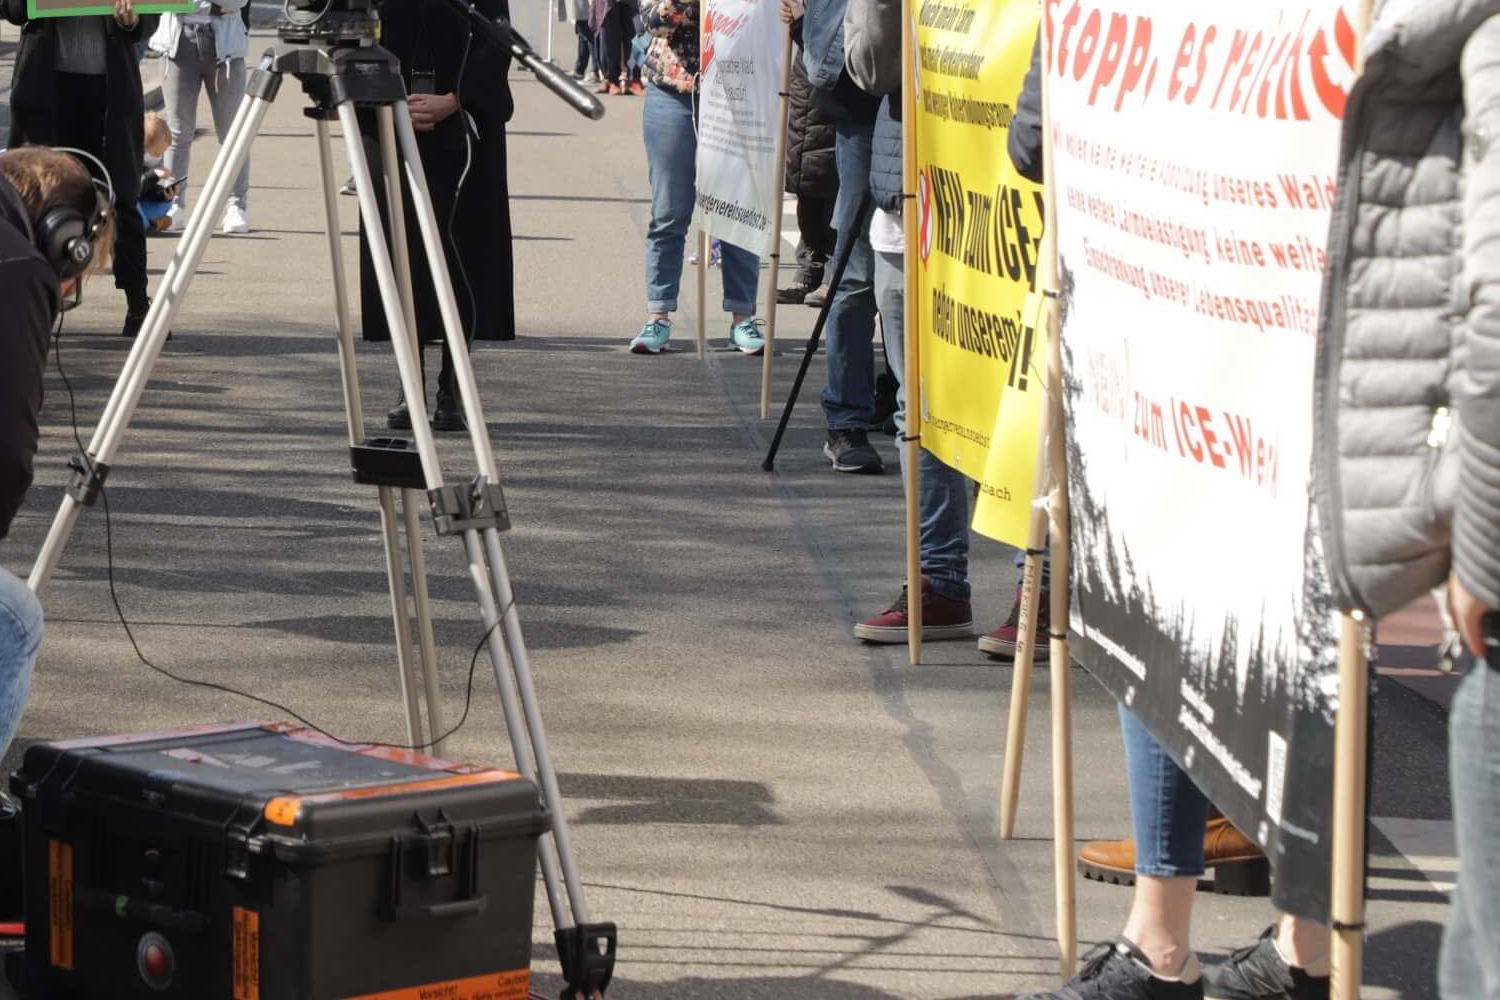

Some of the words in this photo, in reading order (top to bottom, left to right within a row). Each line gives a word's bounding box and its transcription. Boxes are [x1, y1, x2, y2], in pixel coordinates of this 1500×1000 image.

[1167, 21, 1217, 106] es
[929, 164, 966, 264] NEIN
[962, 189, 993, 275] zum
[1214, 227, 1266, 268] keine
[932, 283, 957, 346] neben
[1133, 390, 1168, 452] zum
